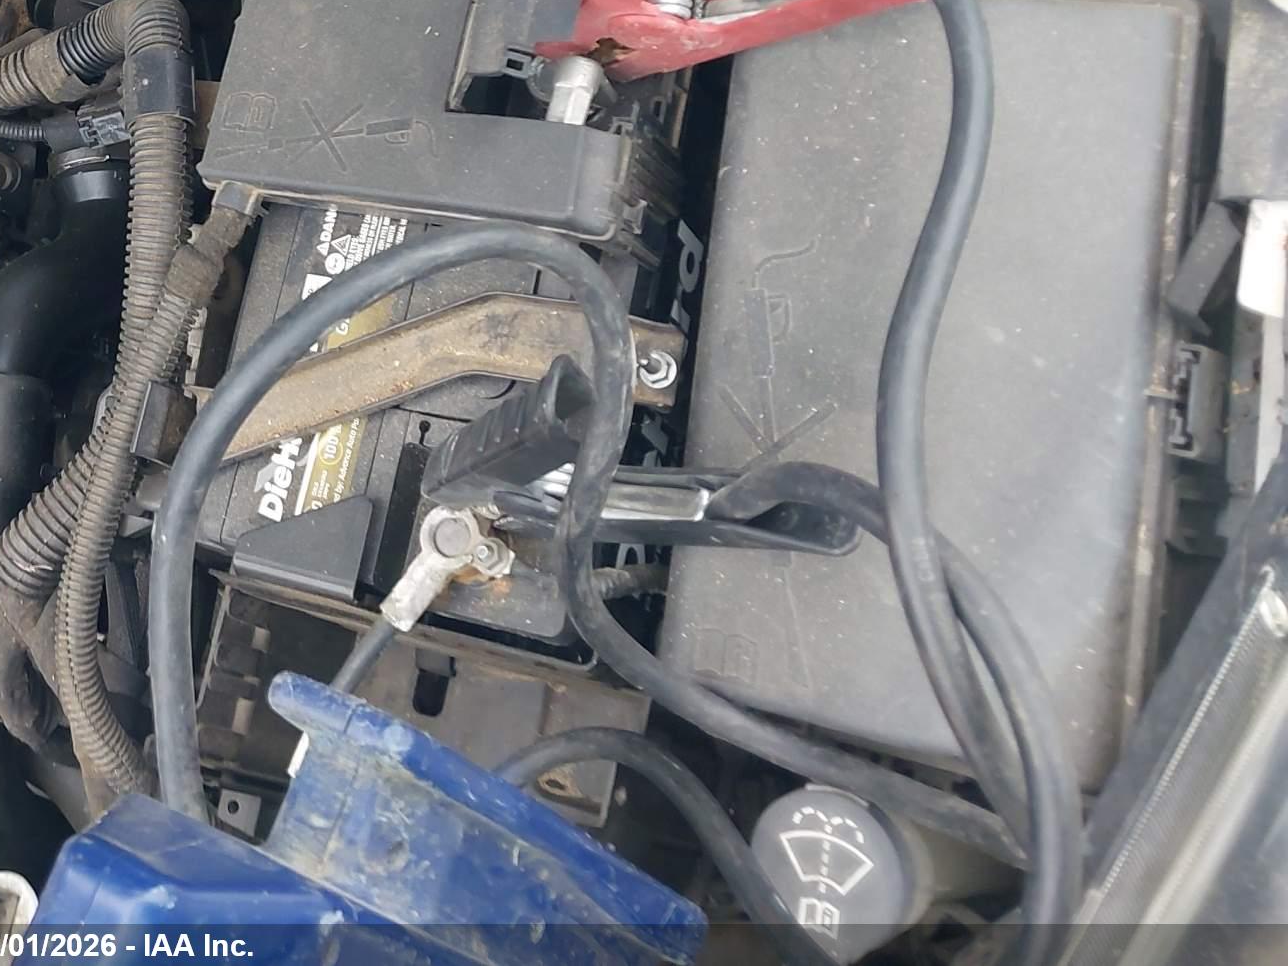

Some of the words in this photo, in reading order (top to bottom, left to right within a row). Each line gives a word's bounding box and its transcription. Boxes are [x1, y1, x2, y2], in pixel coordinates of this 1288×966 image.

[325, 436, 339, 460] 100
[338, 448, 353, 480] Advance
[347, 430, 357, 448] Auto
